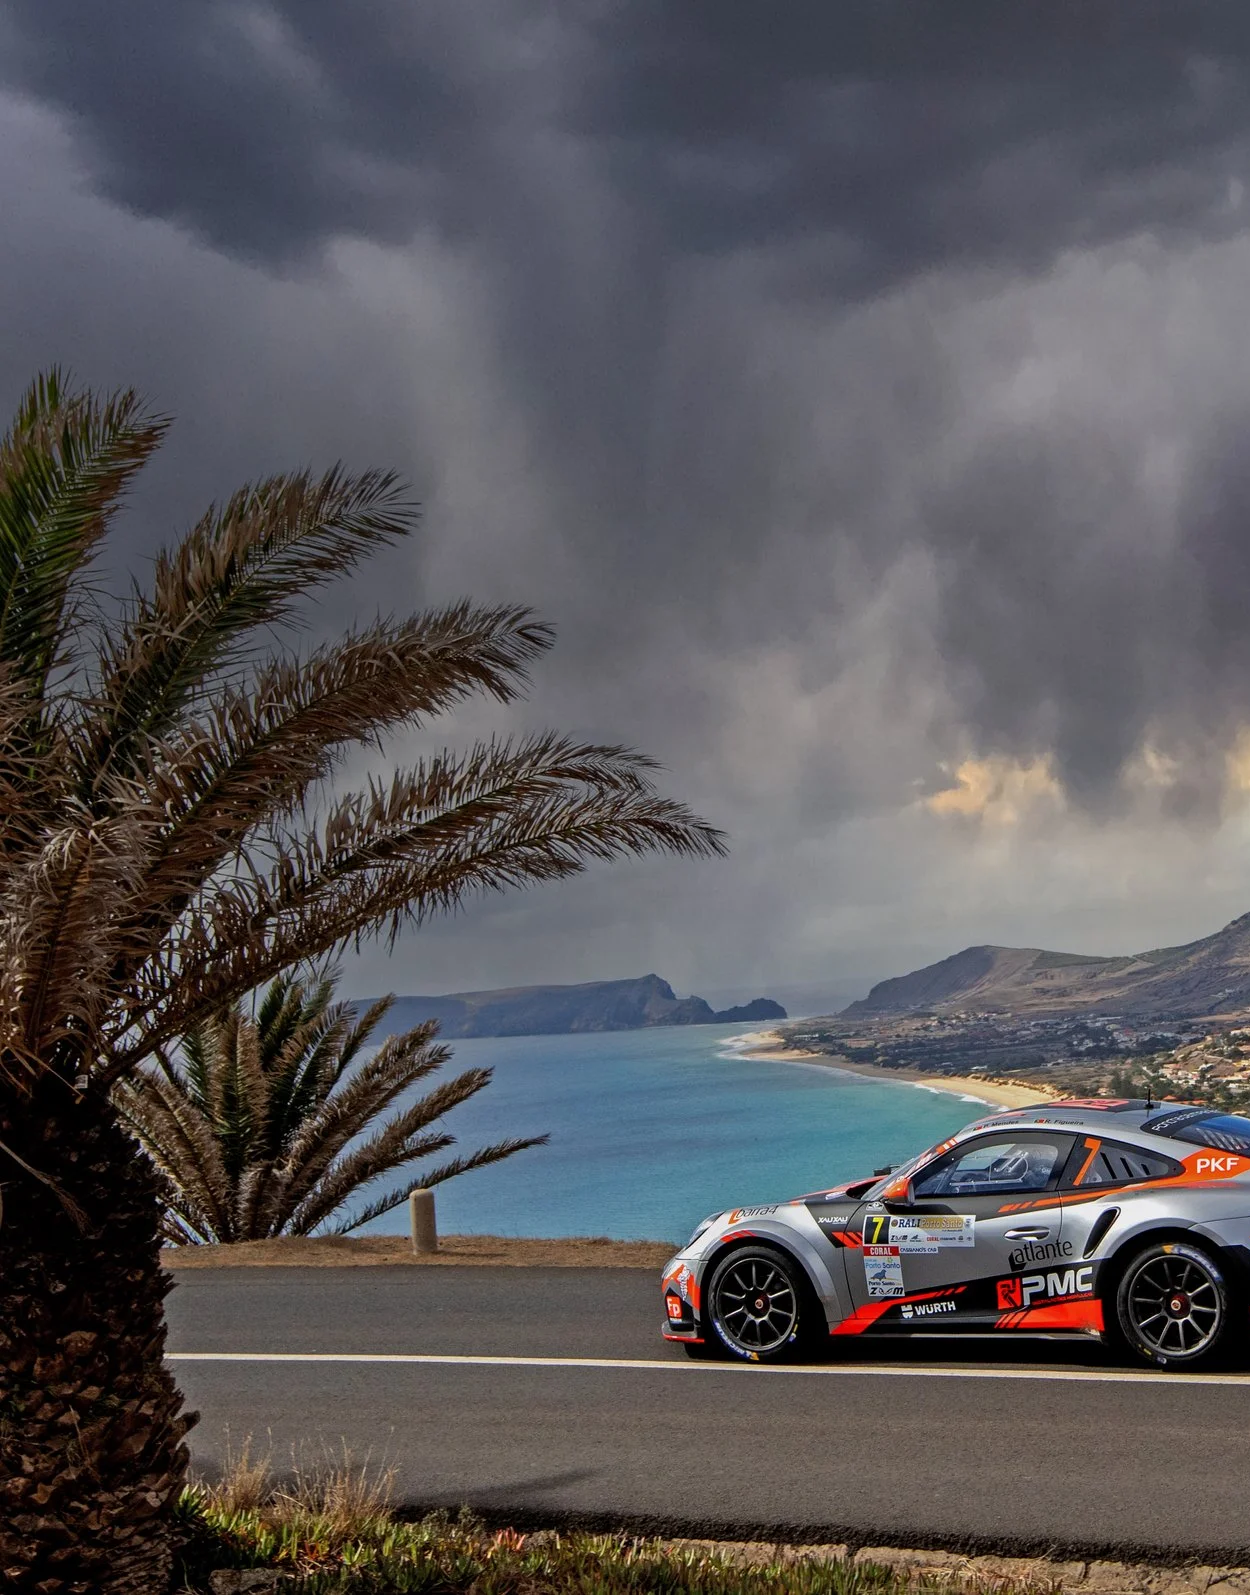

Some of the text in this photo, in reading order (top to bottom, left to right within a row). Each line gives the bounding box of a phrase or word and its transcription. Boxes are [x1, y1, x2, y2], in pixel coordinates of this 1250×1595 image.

[1073, 1137, 1102, 1186] 7
[1196, 1157, 1240, 1174] PKF
[736, 1205, 779, 1218] barra4
[872, 1217, 884, 1244] 7
[899, 1219, 920, 1228] RALI
[922, 1219, 940, 1228] Porto
[942, 1218, 964, 1227] Santo
[870, 1247, 892, 1255] CORAL
[1014, 1239, 1073, 1264] atlante
[1022, 1266, 1093, 1306] PMC
[914, 1301, 957, 1316] WÜRTH
